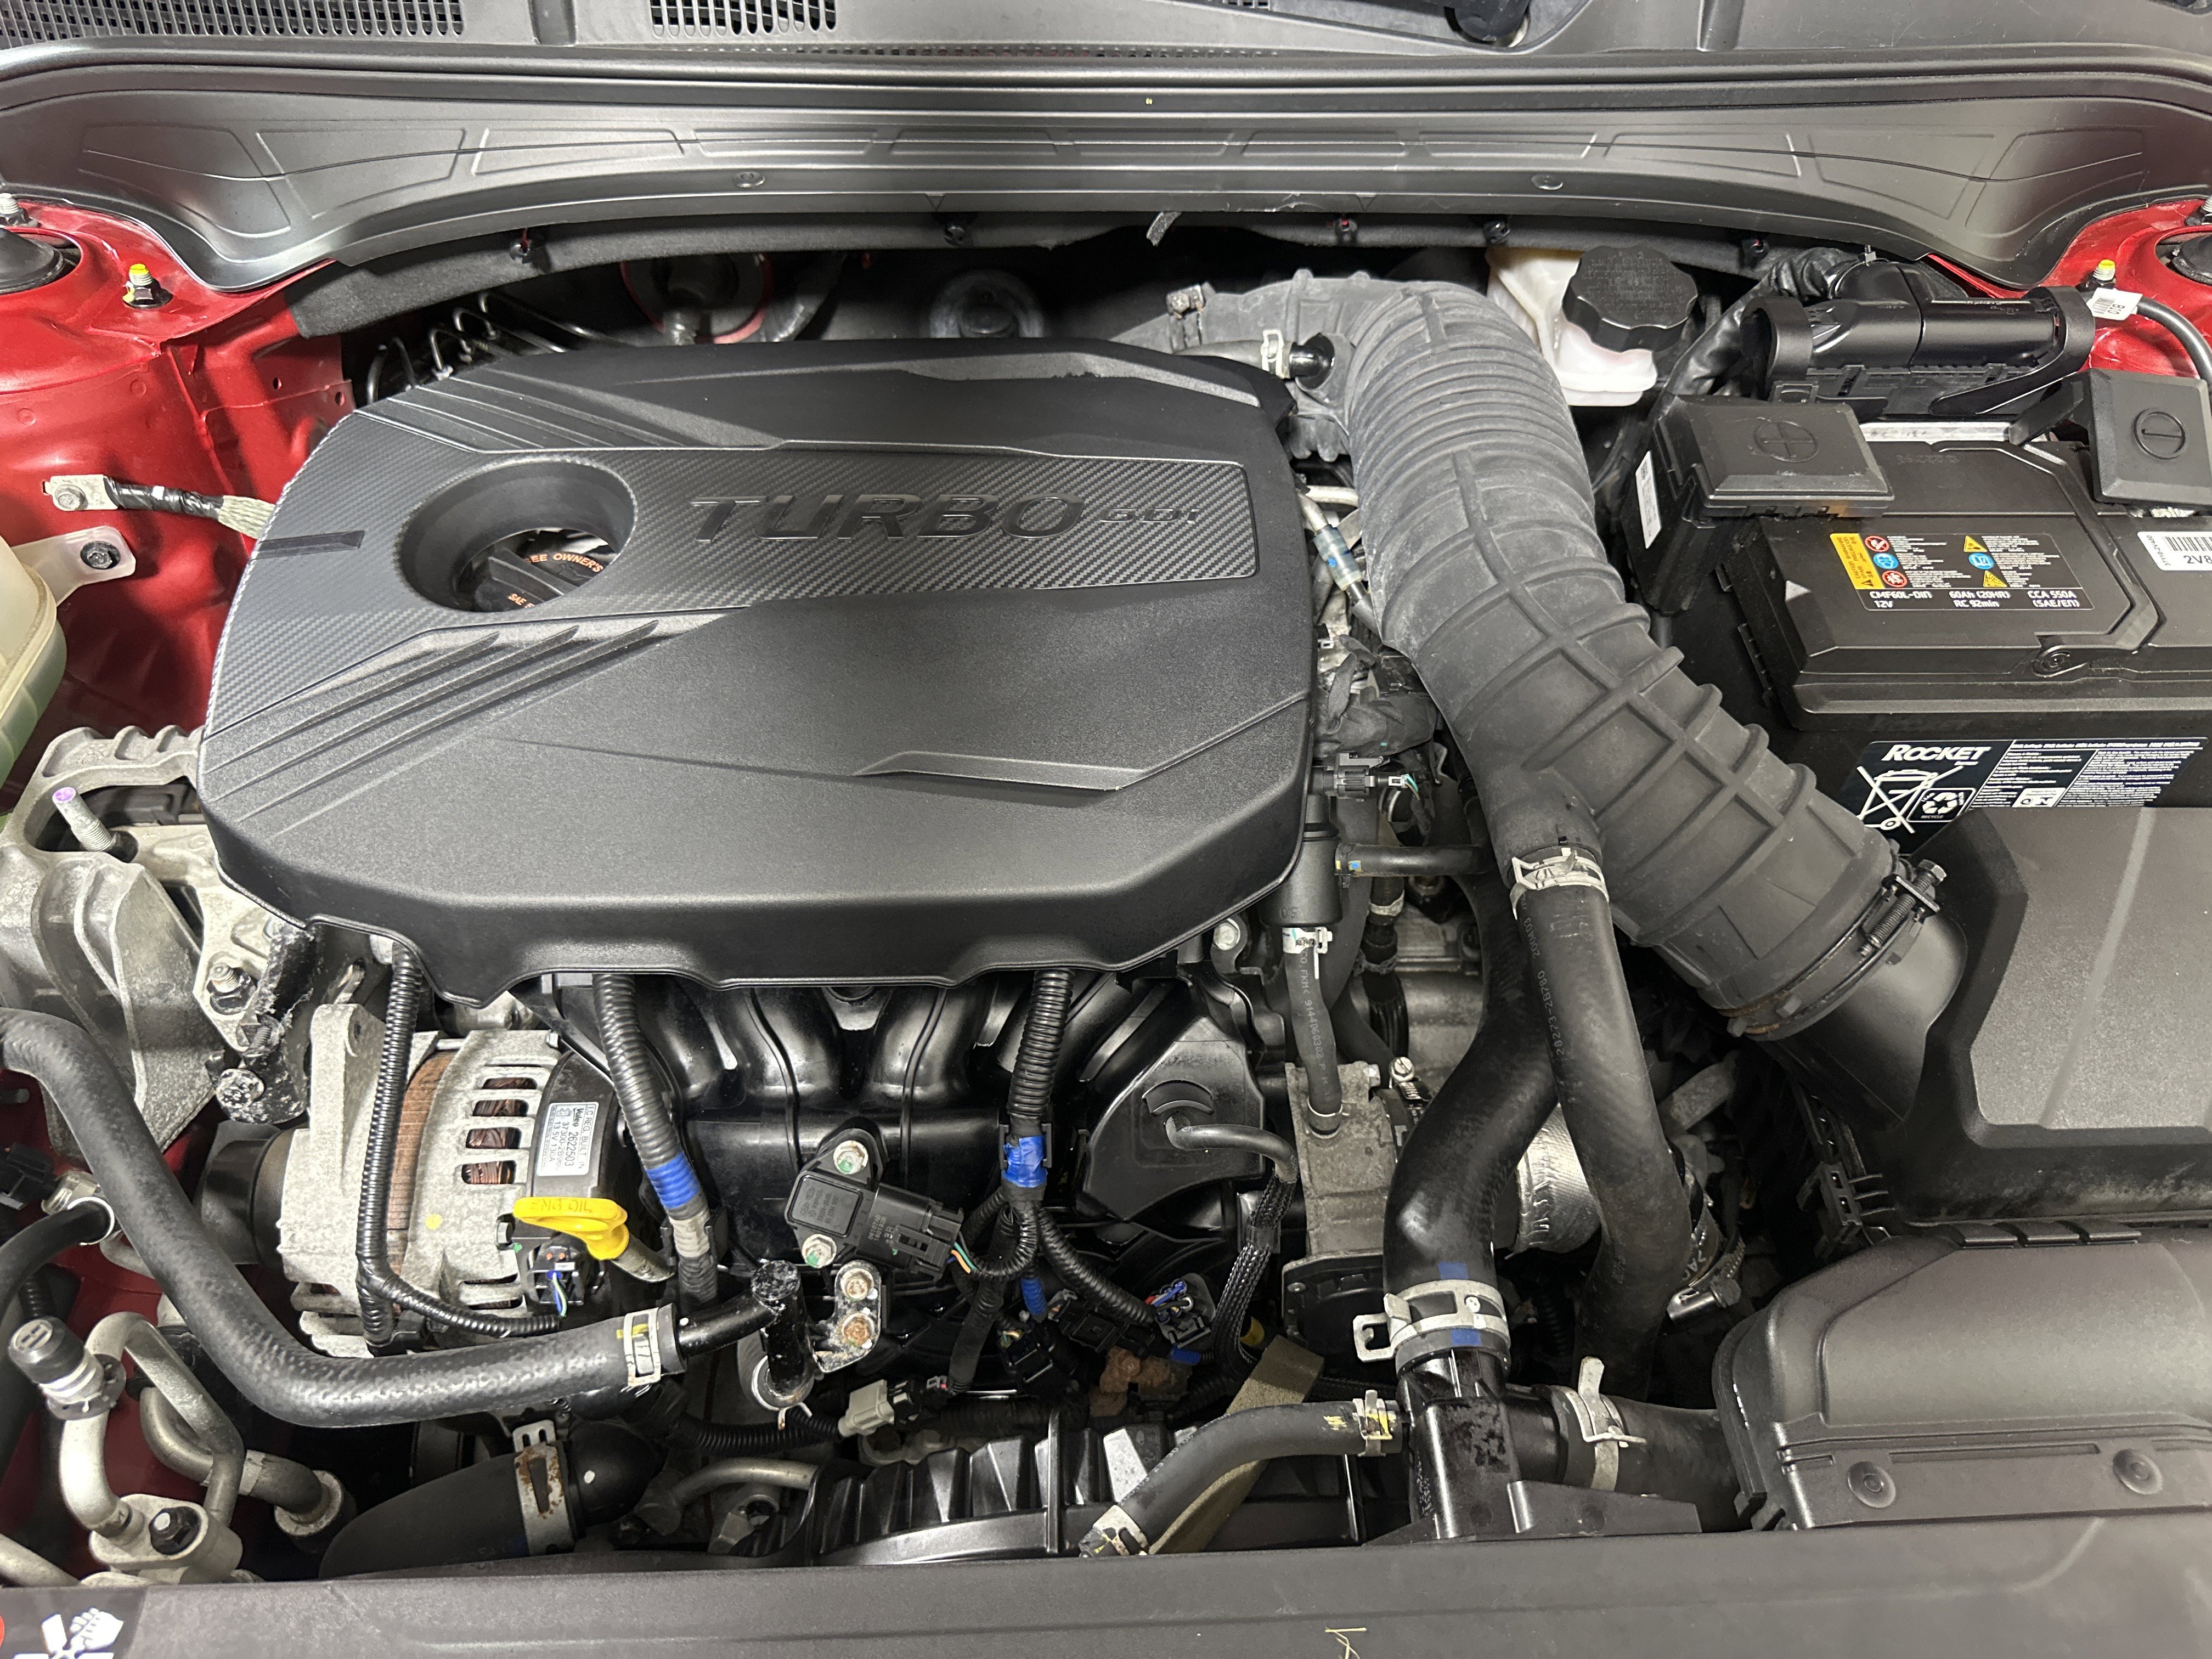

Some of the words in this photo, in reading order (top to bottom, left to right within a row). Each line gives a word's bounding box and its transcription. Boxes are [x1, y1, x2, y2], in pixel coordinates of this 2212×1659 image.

[2108, 304, 2126, 314] B10
[690, 493, 1085, 543] TURBO
[552, 552, 604, 572] OWNER'S
[508, 592, 526, 606] SAE
[1949, 591, 1975, 599] 60Ah
[1976, 590, 2011, 599] (20HR)
[2027, 590, 2050, 599] CCA
[2050, 590, 2077, 599] 550A
[1874, 600, 1893, 608] 12V
[1953, 600, 1969, 608] RC
[1881, 744, 1993, 761] ROCKET
[1537, 970, 1565, 1056] 28273-2B780
[572, 1107, 584, 1127] Valeo
[551, 1121, 561, 1141] 13.5V
[548, 1144, 556, 1162] 130A
[564, 1131, 579, 1166] 2622503
[578, 1136, 589, 1156] BUILT
[577, 1161, 585, 1169] IN
[531, 1198, 562, 1211] ENG
[568, 1199, 592, 1214] OIL
